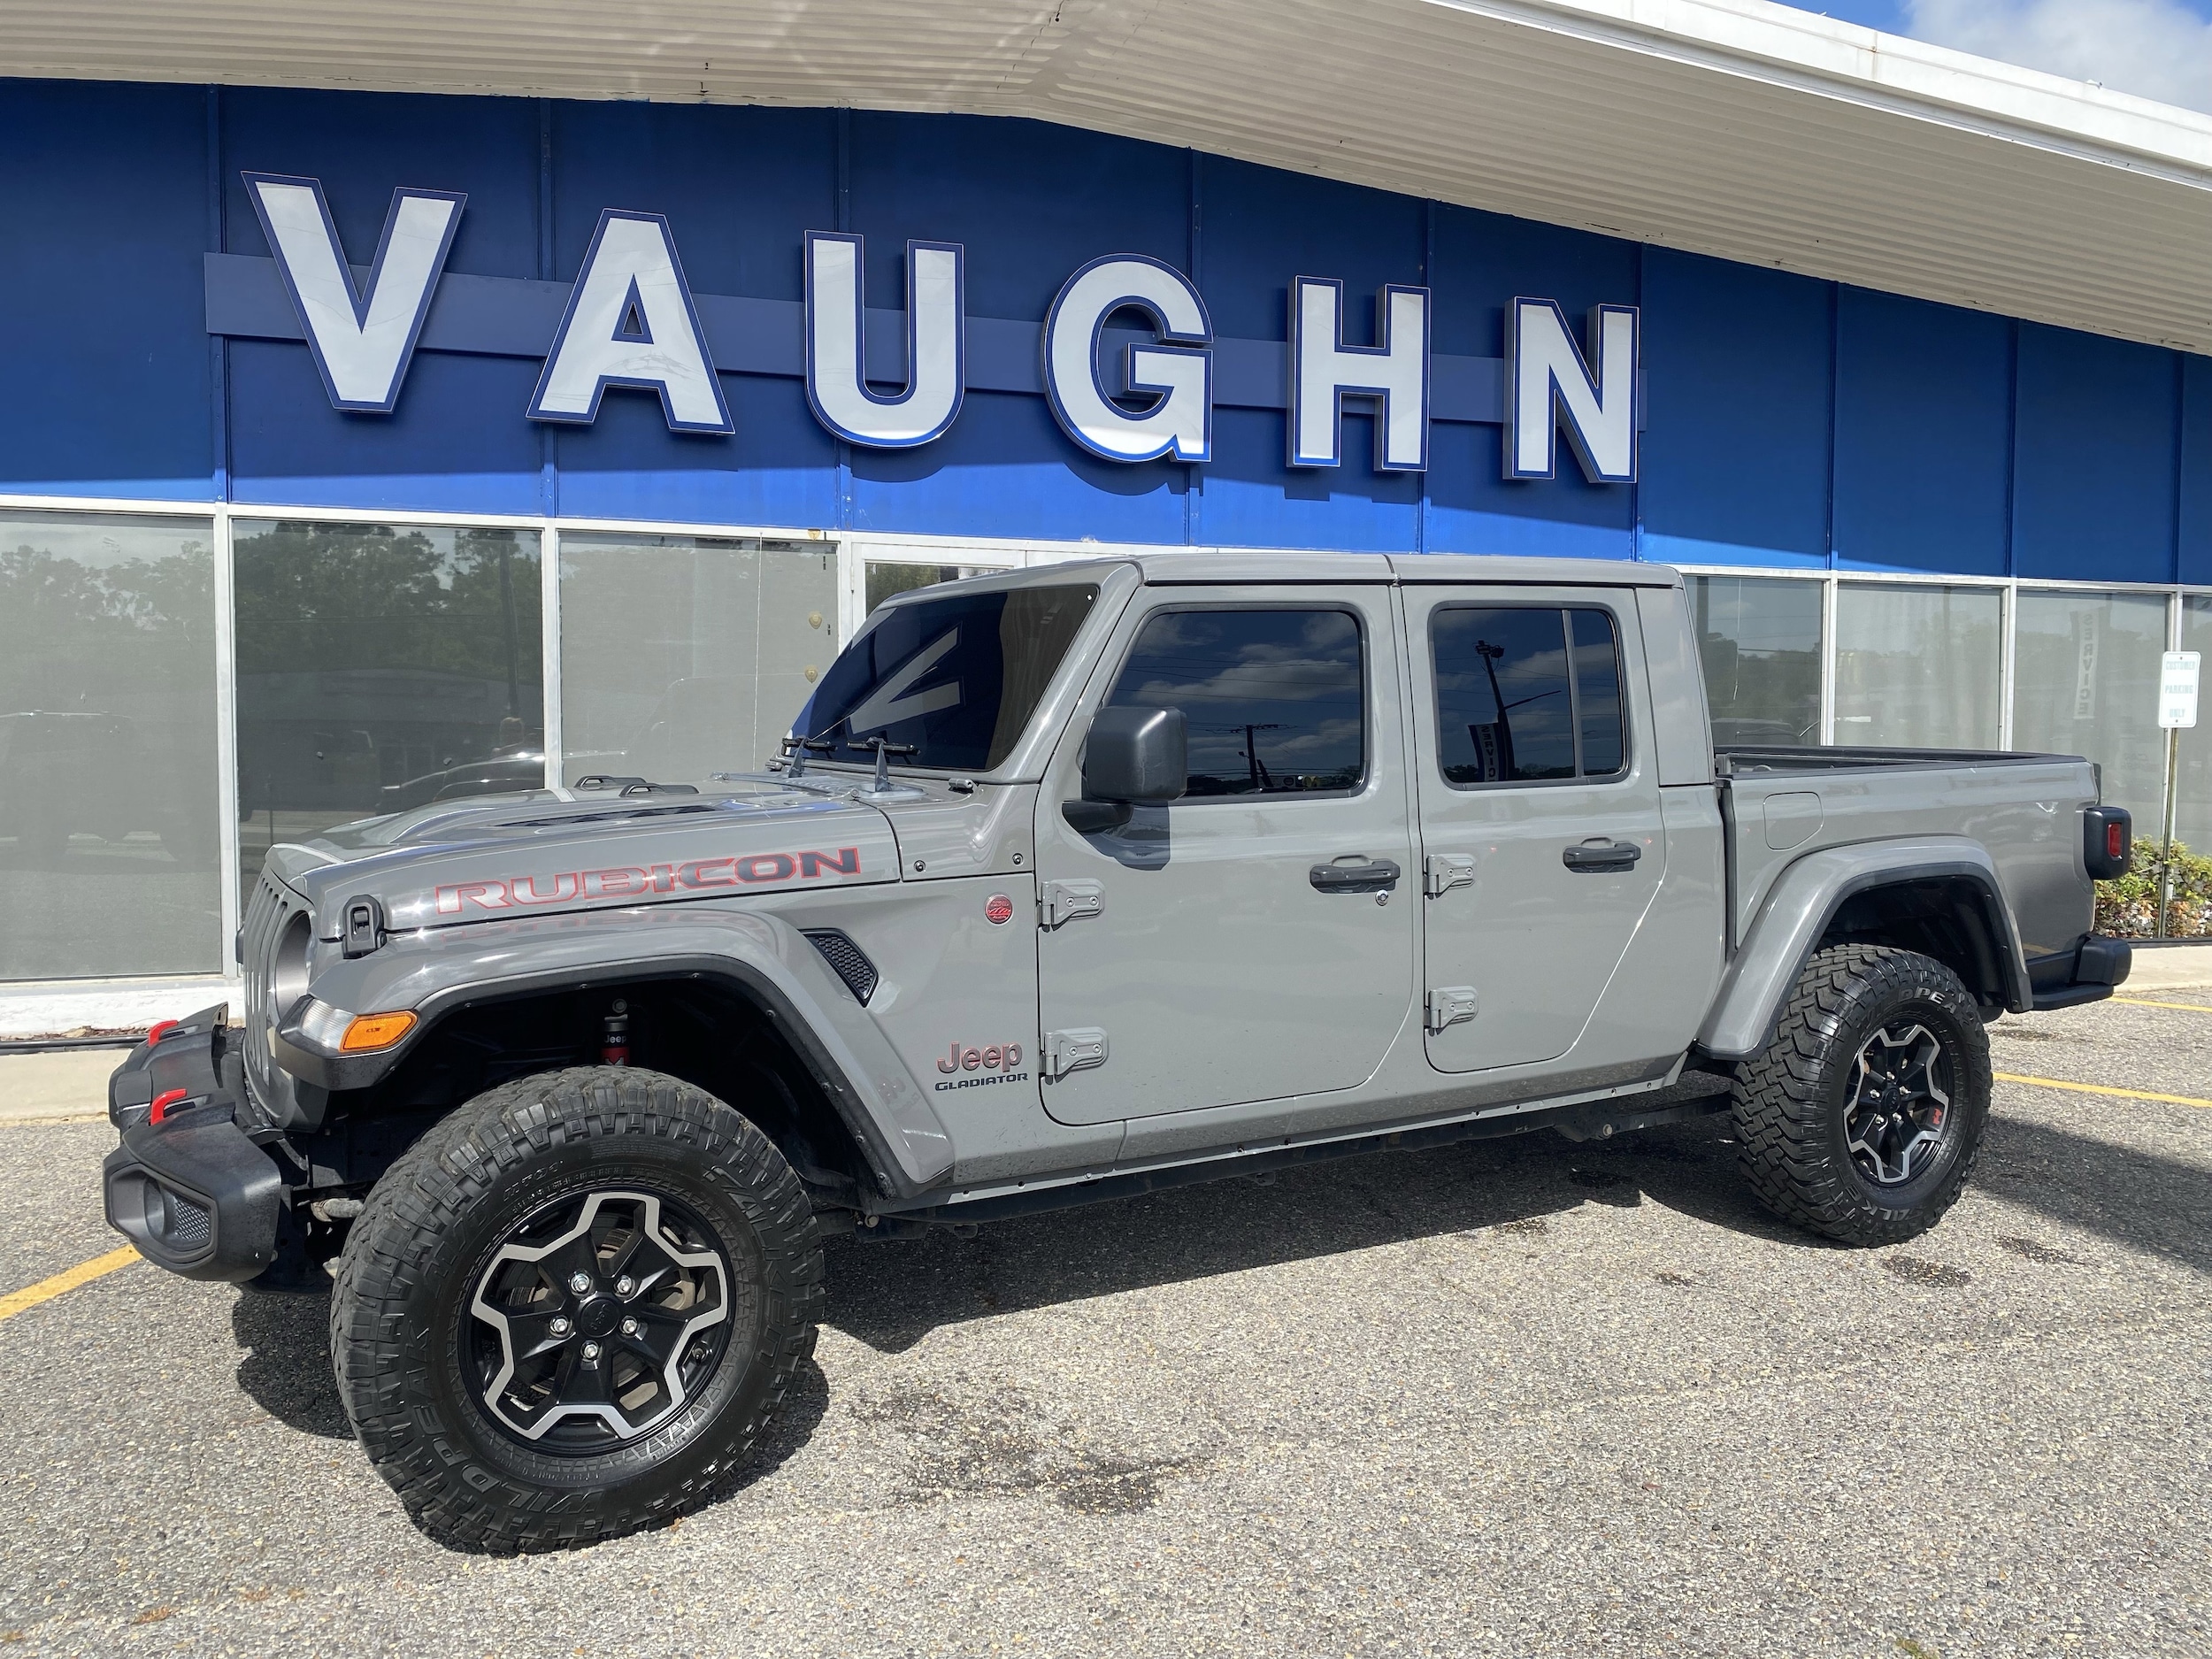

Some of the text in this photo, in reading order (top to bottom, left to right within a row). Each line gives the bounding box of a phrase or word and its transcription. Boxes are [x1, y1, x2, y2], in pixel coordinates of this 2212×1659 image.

[242, 170, 1640, 484] VAUGHN
[2165, 660, 2196, 671] CUSTOMER
[2164, 684, 2194, 695] PARKING
[2169, 708, 2186, 718] ONLY
[434, 846, 862, 915] RUBICON
[604, 1034, 627, 1044] Jeep
[936, 1041, 1023, 1075] Jeep
[934, 1072, 1029, 1092] GLADIATOR
[702, 1163, 787, 1369] FALKEN
[404, 1326, 605, 1515] WILDPEAK
